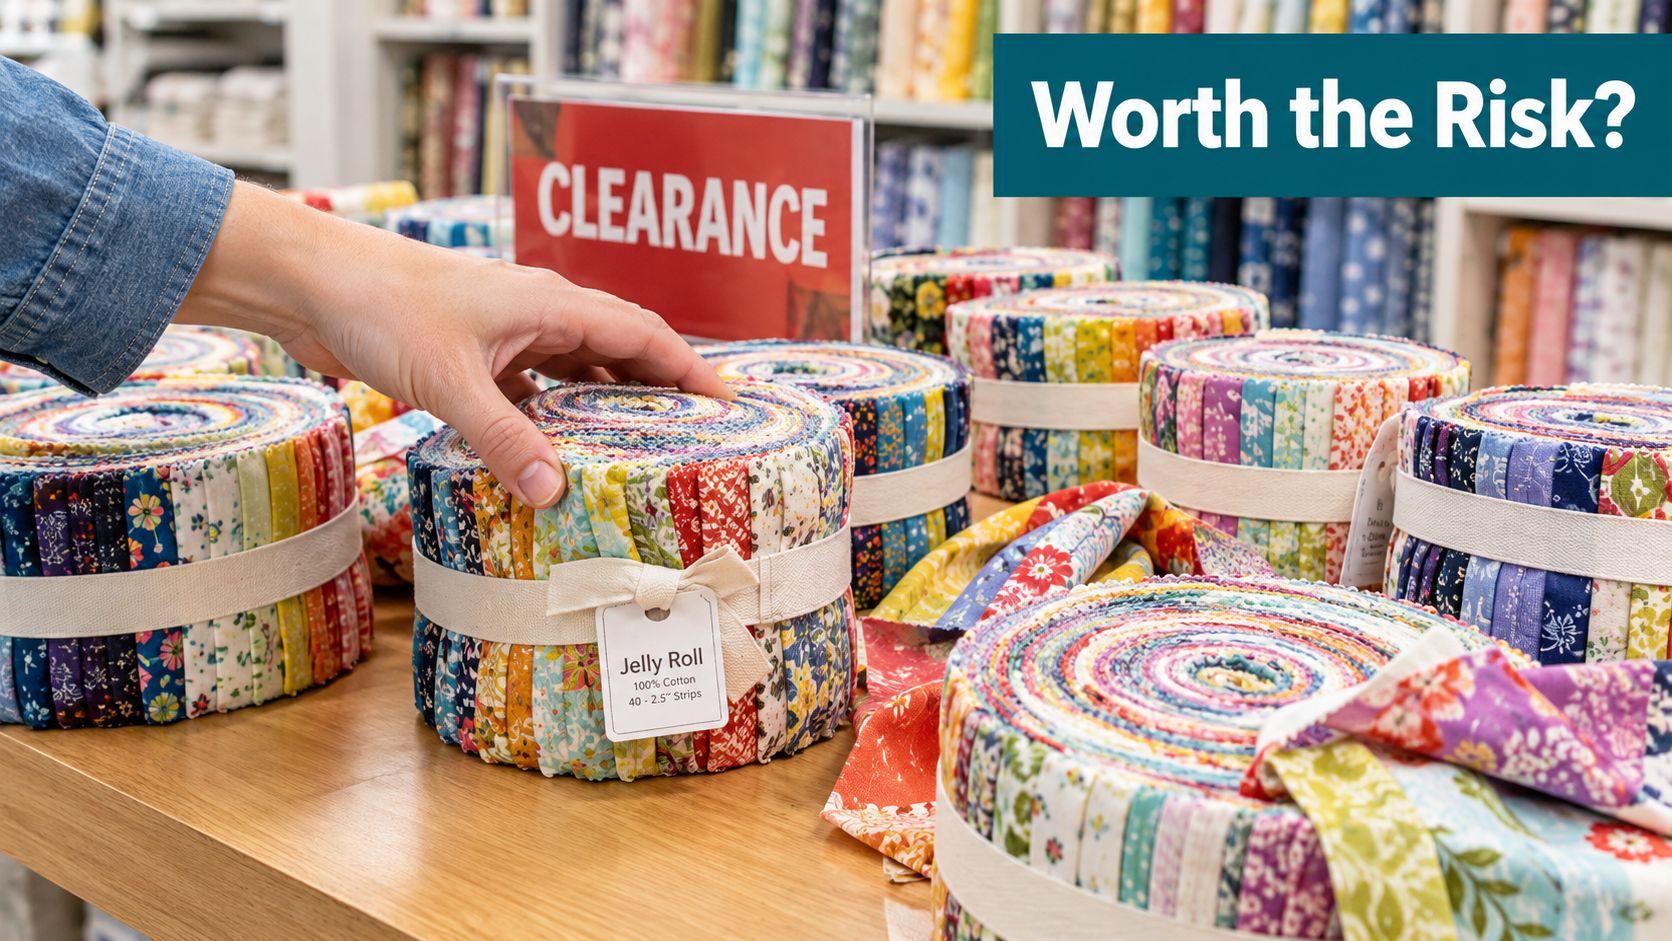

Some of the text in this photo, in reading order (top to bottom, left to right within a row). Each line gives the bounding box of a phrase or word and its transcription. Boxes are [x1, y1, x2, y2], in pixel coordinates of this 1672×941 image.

[537, 161, 828, 269] CLEARANCE
[620, 648, 703, 675] Jelly Roll
[634, 676, 695, 690] 100% Cotton
[629, 697, 641, 706] 40
[674, 690, 702, 700] Strips
